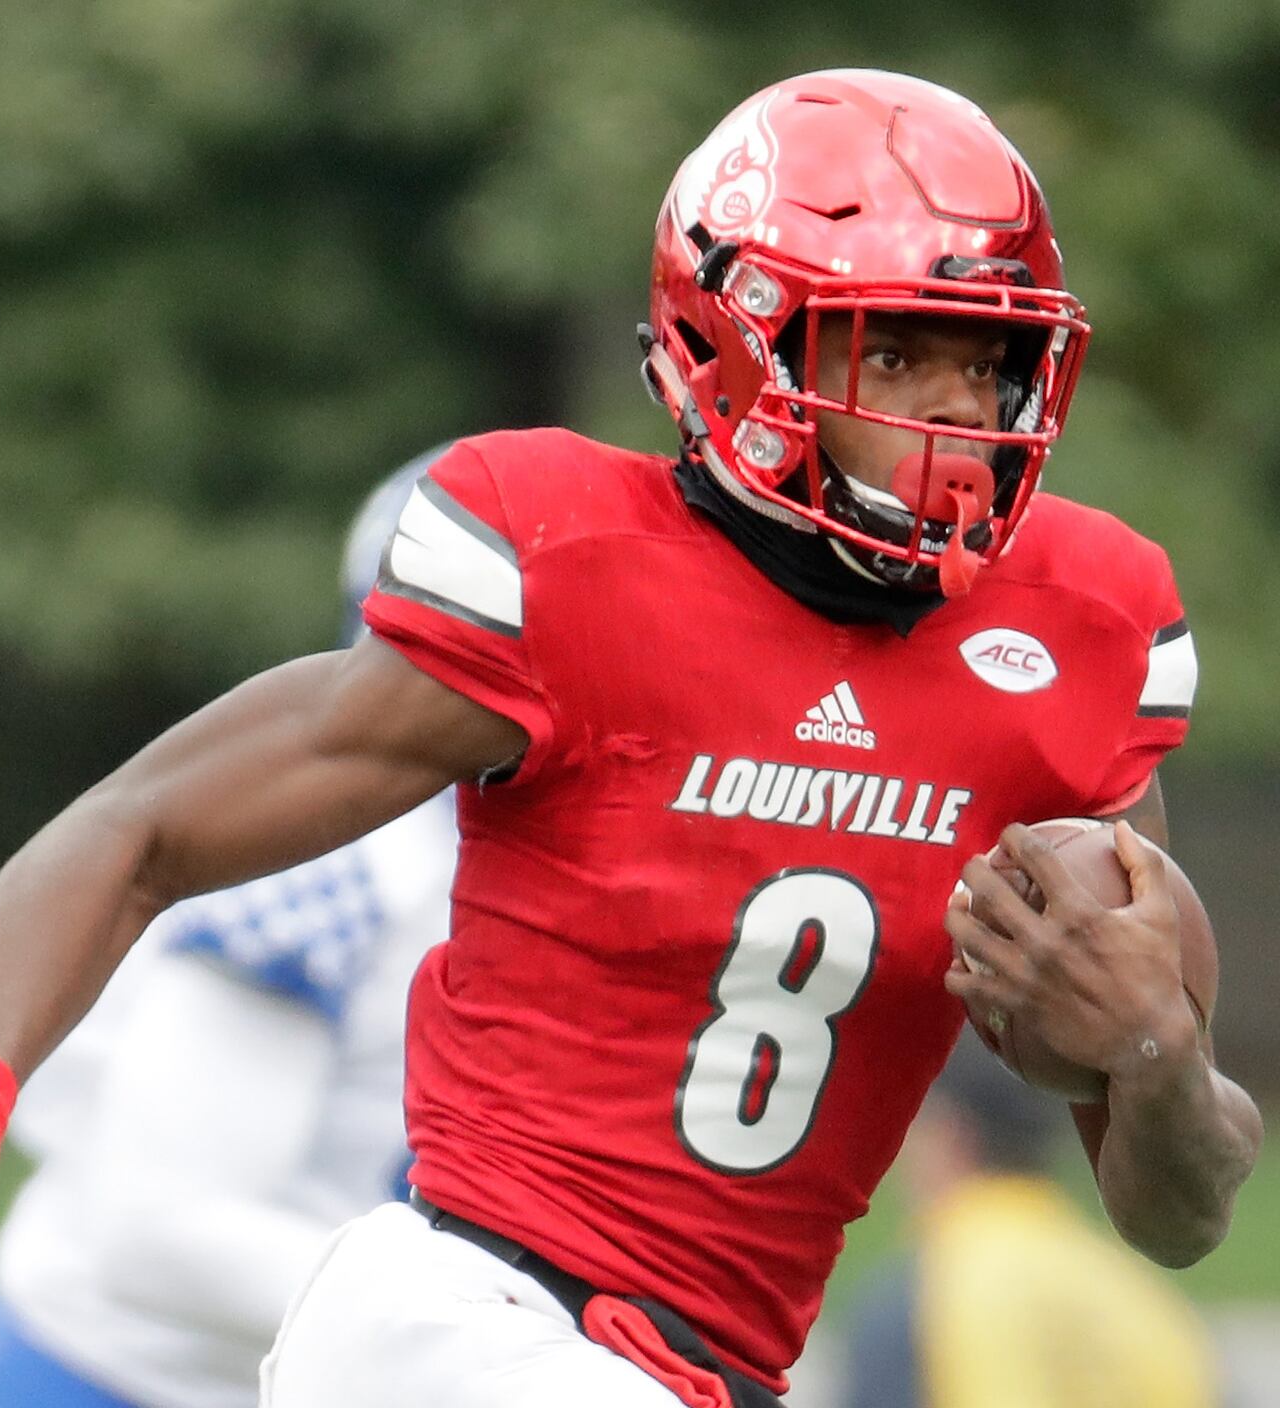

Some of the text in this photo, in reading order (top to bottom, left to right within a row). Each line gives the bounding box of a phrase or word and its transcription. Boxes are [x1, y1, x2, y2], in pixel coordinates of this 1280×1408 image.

[976, 644, 1044, 672] ACC
[795, 719, 876, 750] adidas
[671, 754, 974, 845] LOUISVILLE
[676, 867, 879, 1176] 8
